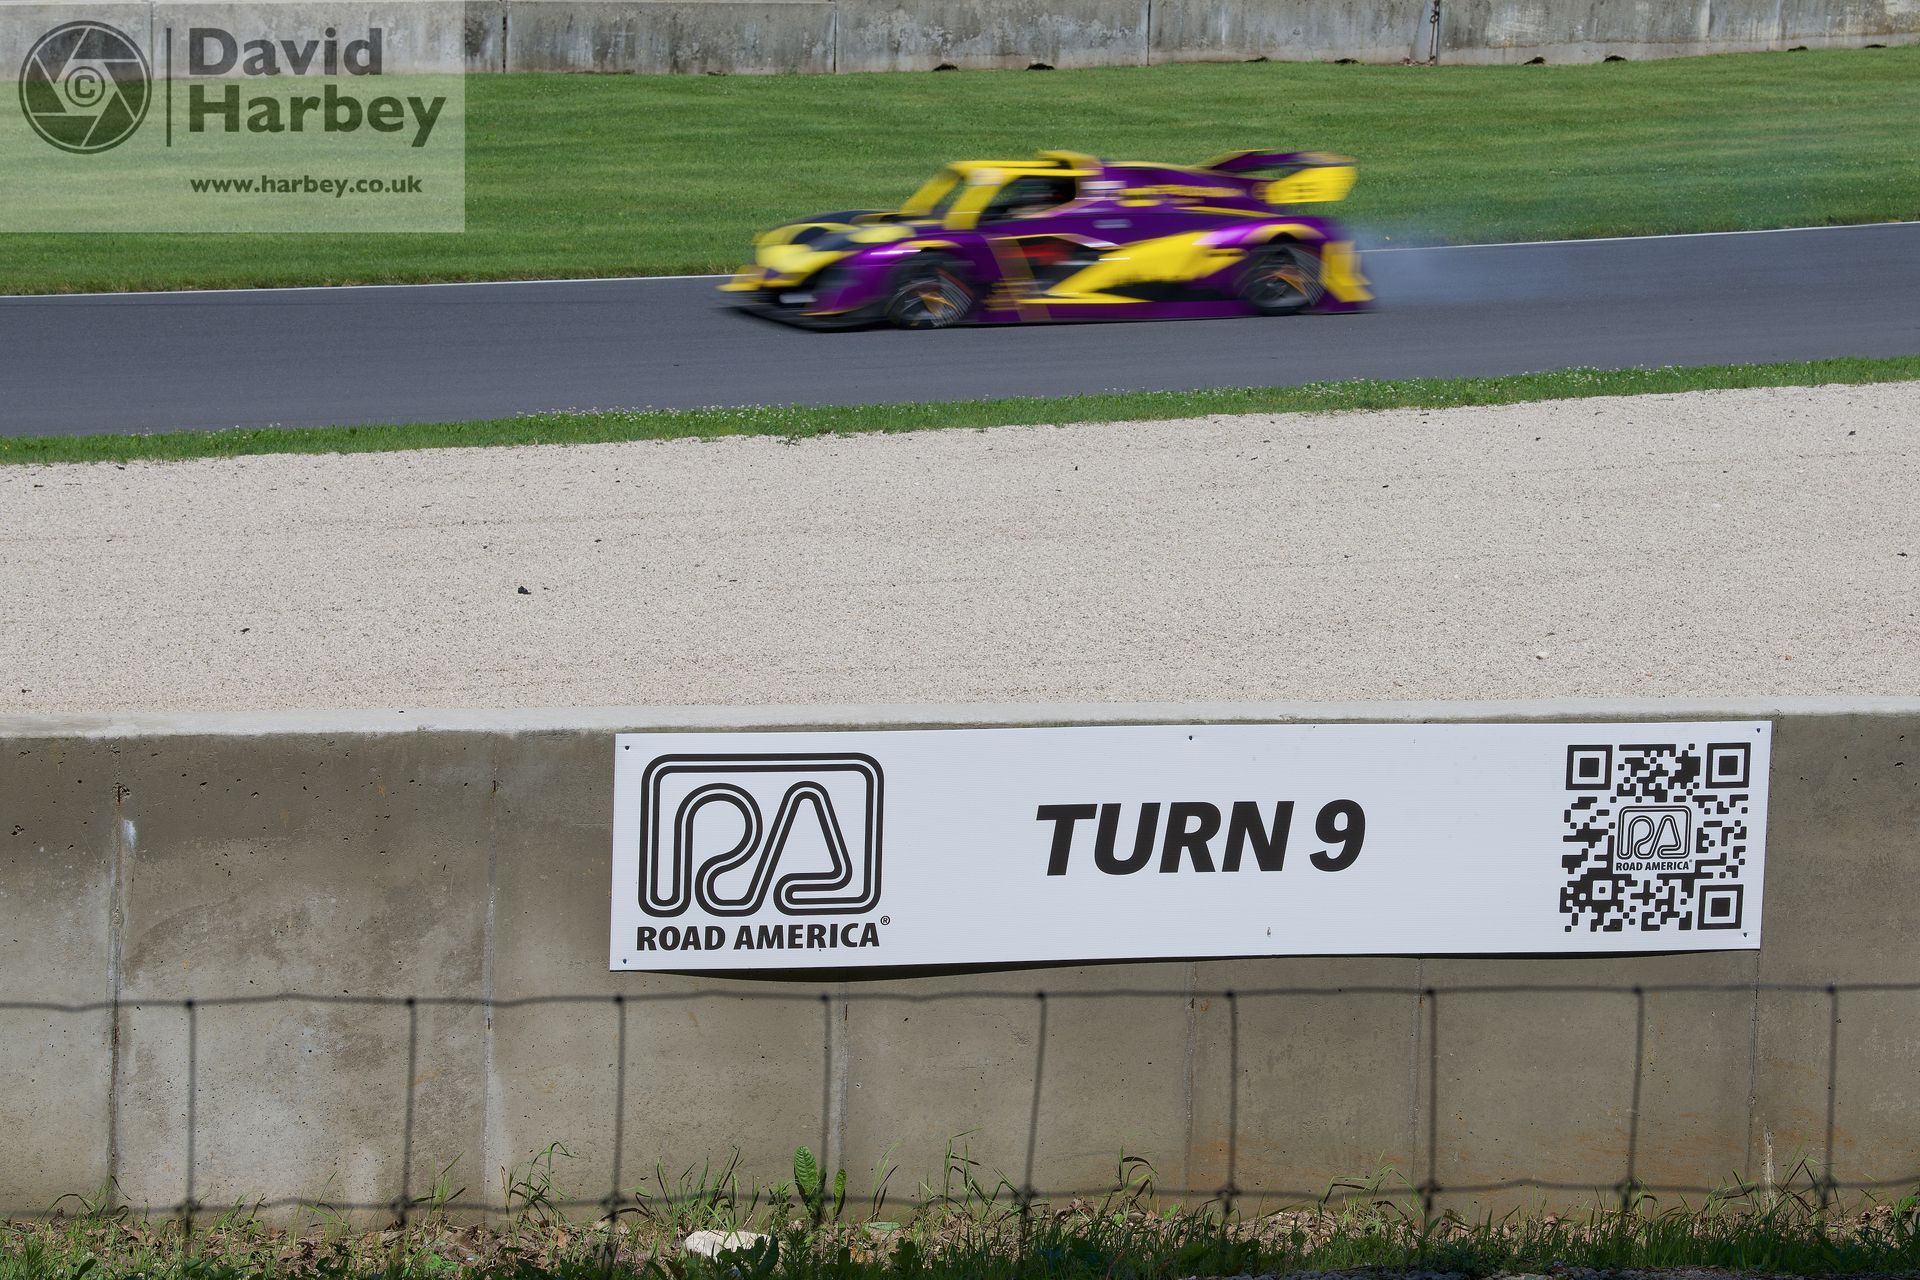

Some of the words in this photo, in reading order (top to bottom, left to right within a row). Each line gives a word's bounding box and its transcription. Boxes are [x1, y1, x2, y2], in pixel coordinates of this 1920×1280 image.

[1036, 800, 1295, 876] TURN
[1309, 799, 1366, 873] 9
[1615, 861, 1643, 872] ROAD
[1644, 860, 1689, 871] AMERICA
[636, 925, 726, 951] ROAD
